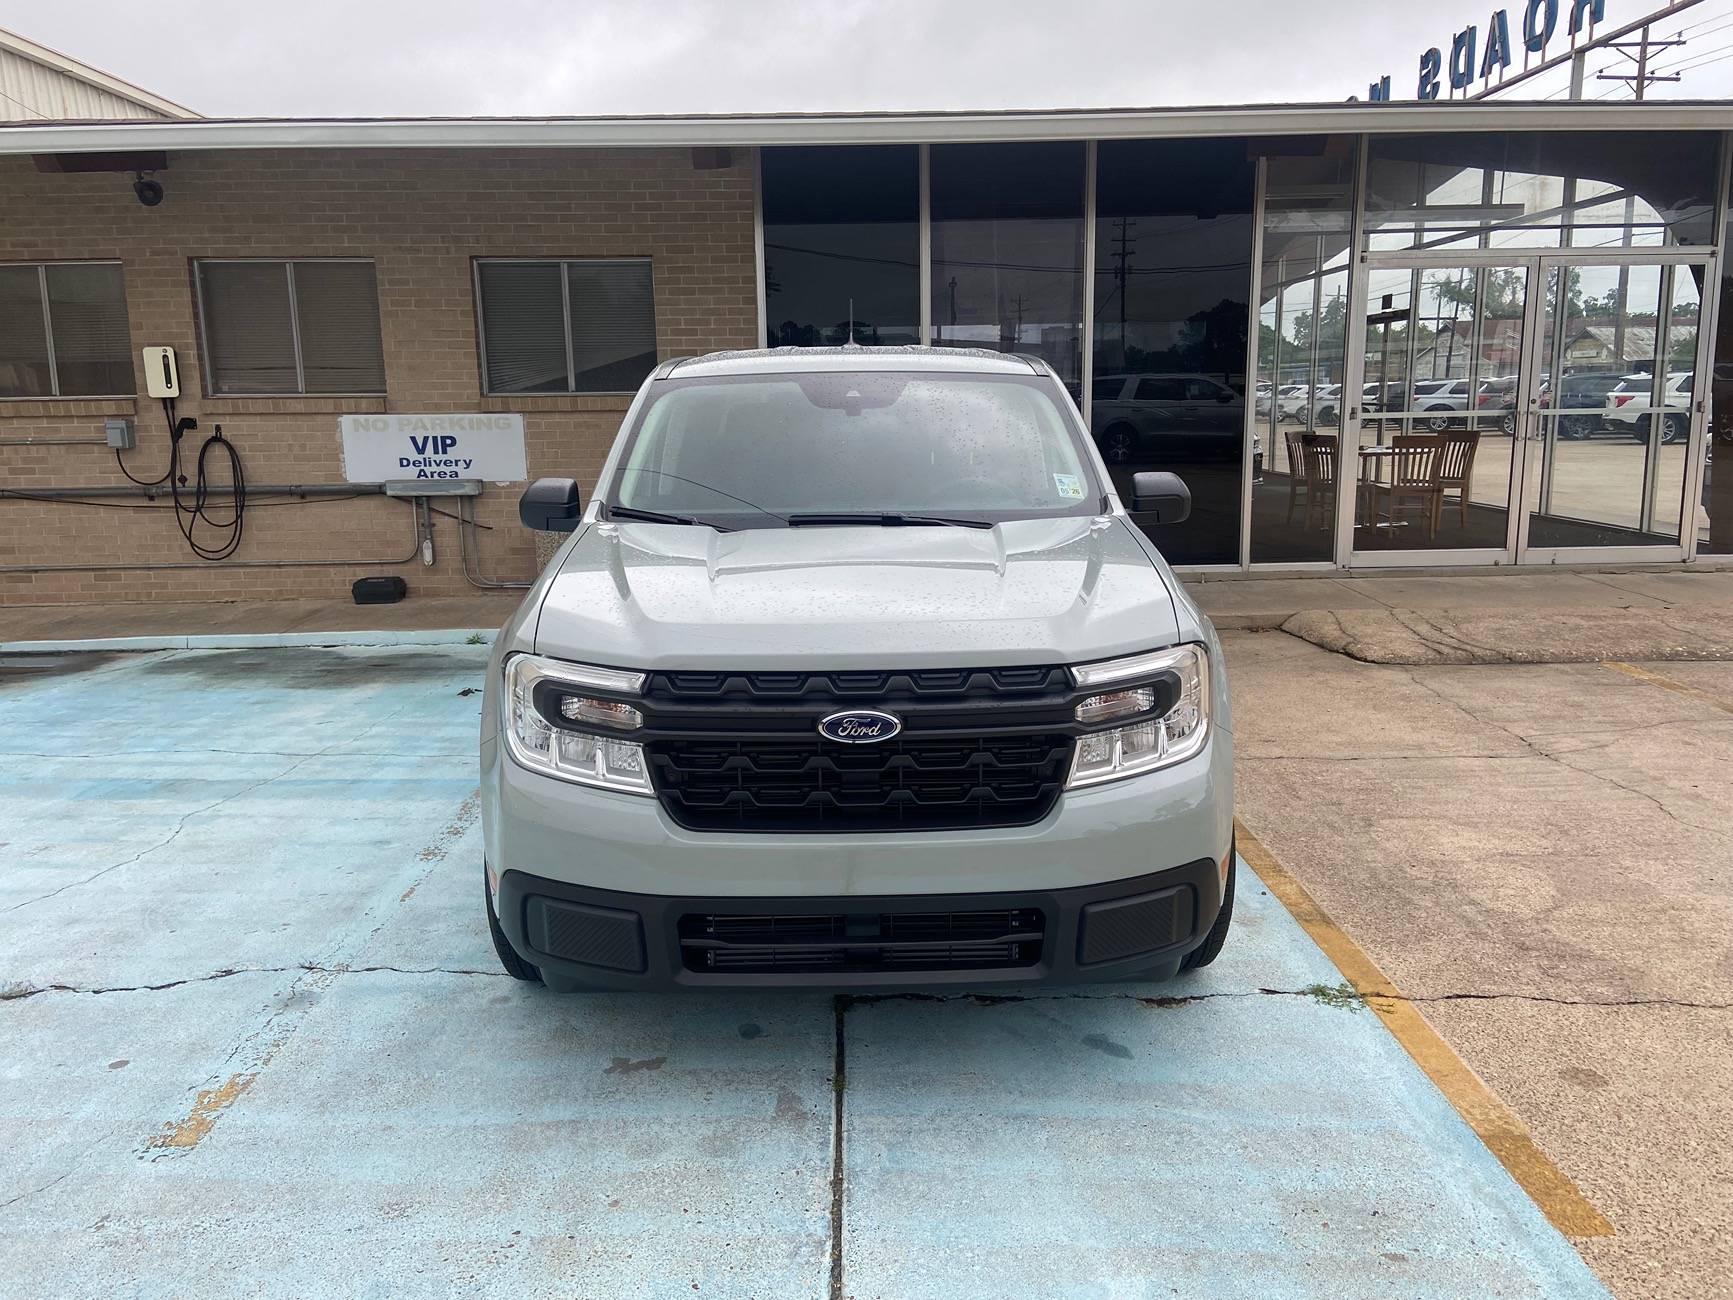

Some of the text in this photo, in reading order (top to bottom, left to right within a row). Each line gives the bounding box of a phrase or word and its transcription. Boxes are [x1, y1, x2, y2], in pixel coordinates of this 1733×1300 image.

[352, 416, 512, 432] NO PARKING
[409, 435, 458, 456] VIP
[399, 457, 473, 469] Delivery
[416, 469, 459, 479] Area
[837, 718, 882, 736] Ford
